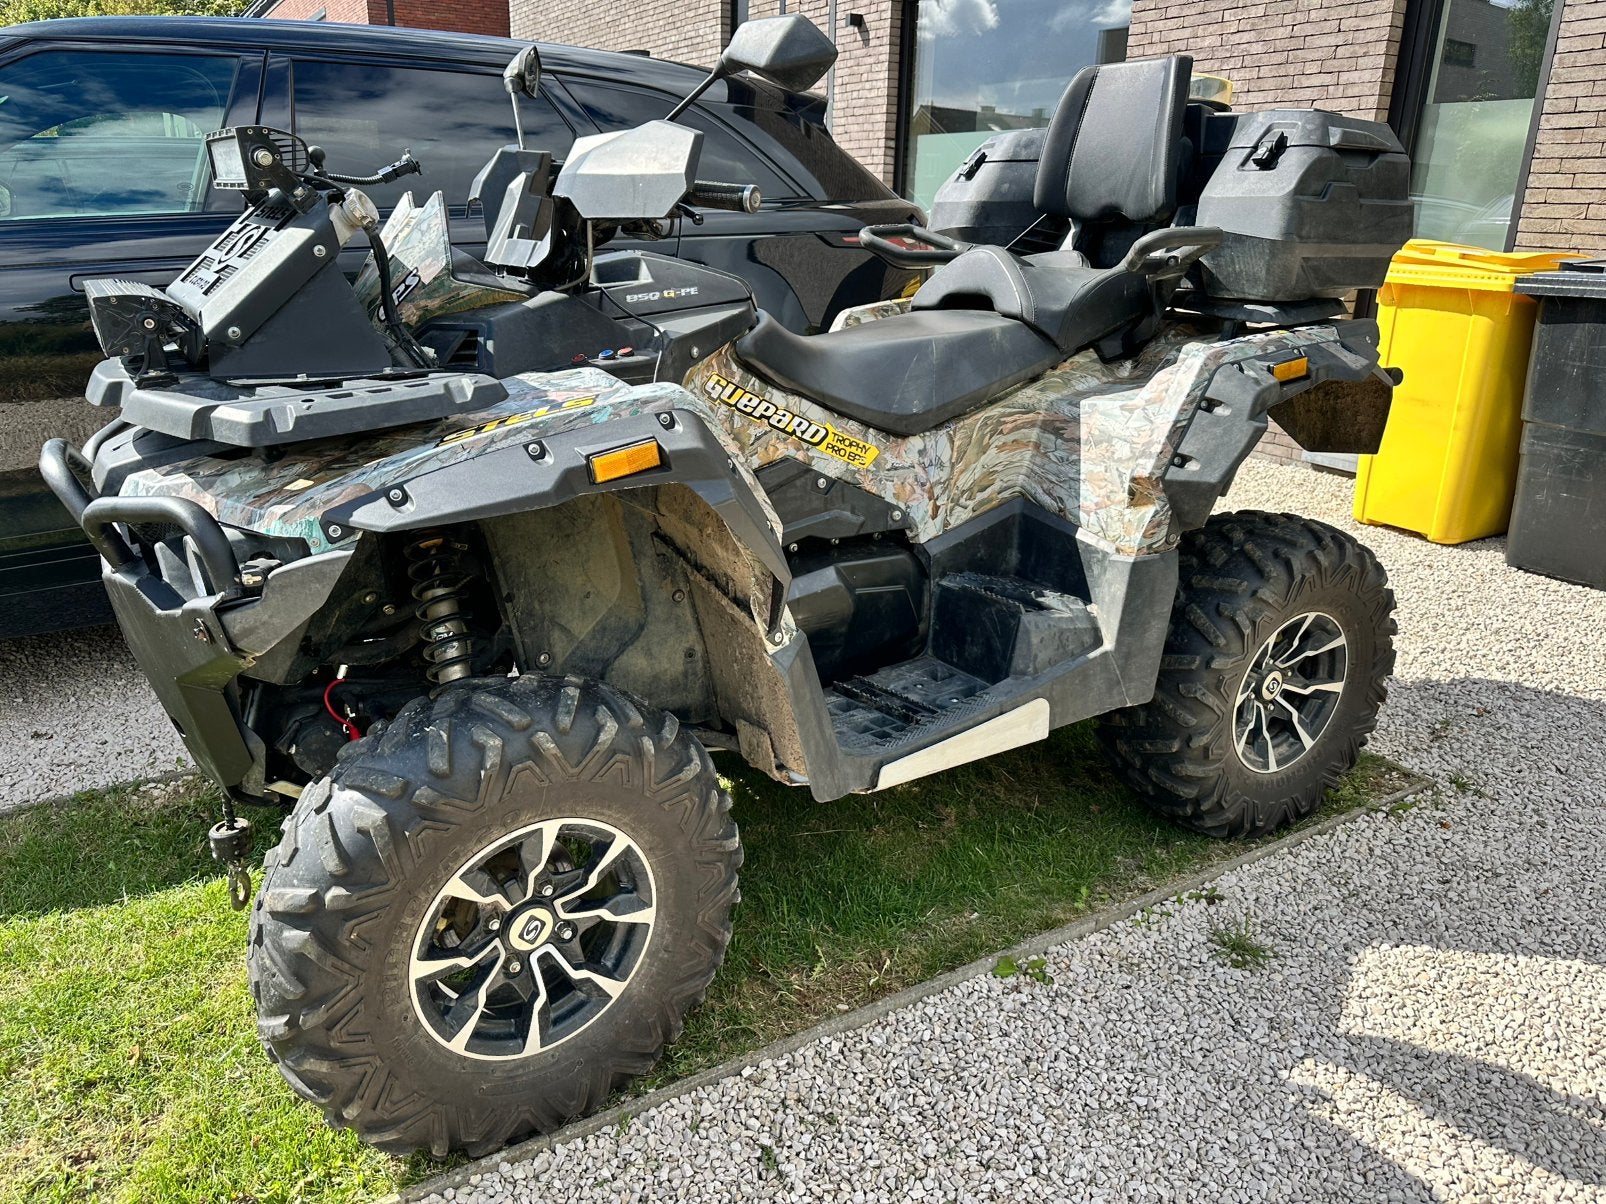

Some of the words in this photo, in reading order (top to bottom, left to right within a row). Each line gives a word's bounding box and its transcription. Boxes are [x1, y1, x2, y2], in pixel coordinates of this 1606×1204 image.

[378, 266, 420, 321] PS
[625, 292, 660, 302] 850
[663, 287, 699, 298] G-PE
[437, 393, 600, 447] STELS
[824, 442, 847, 458] PRO
[831, 431, 872, 455] TROPHY
